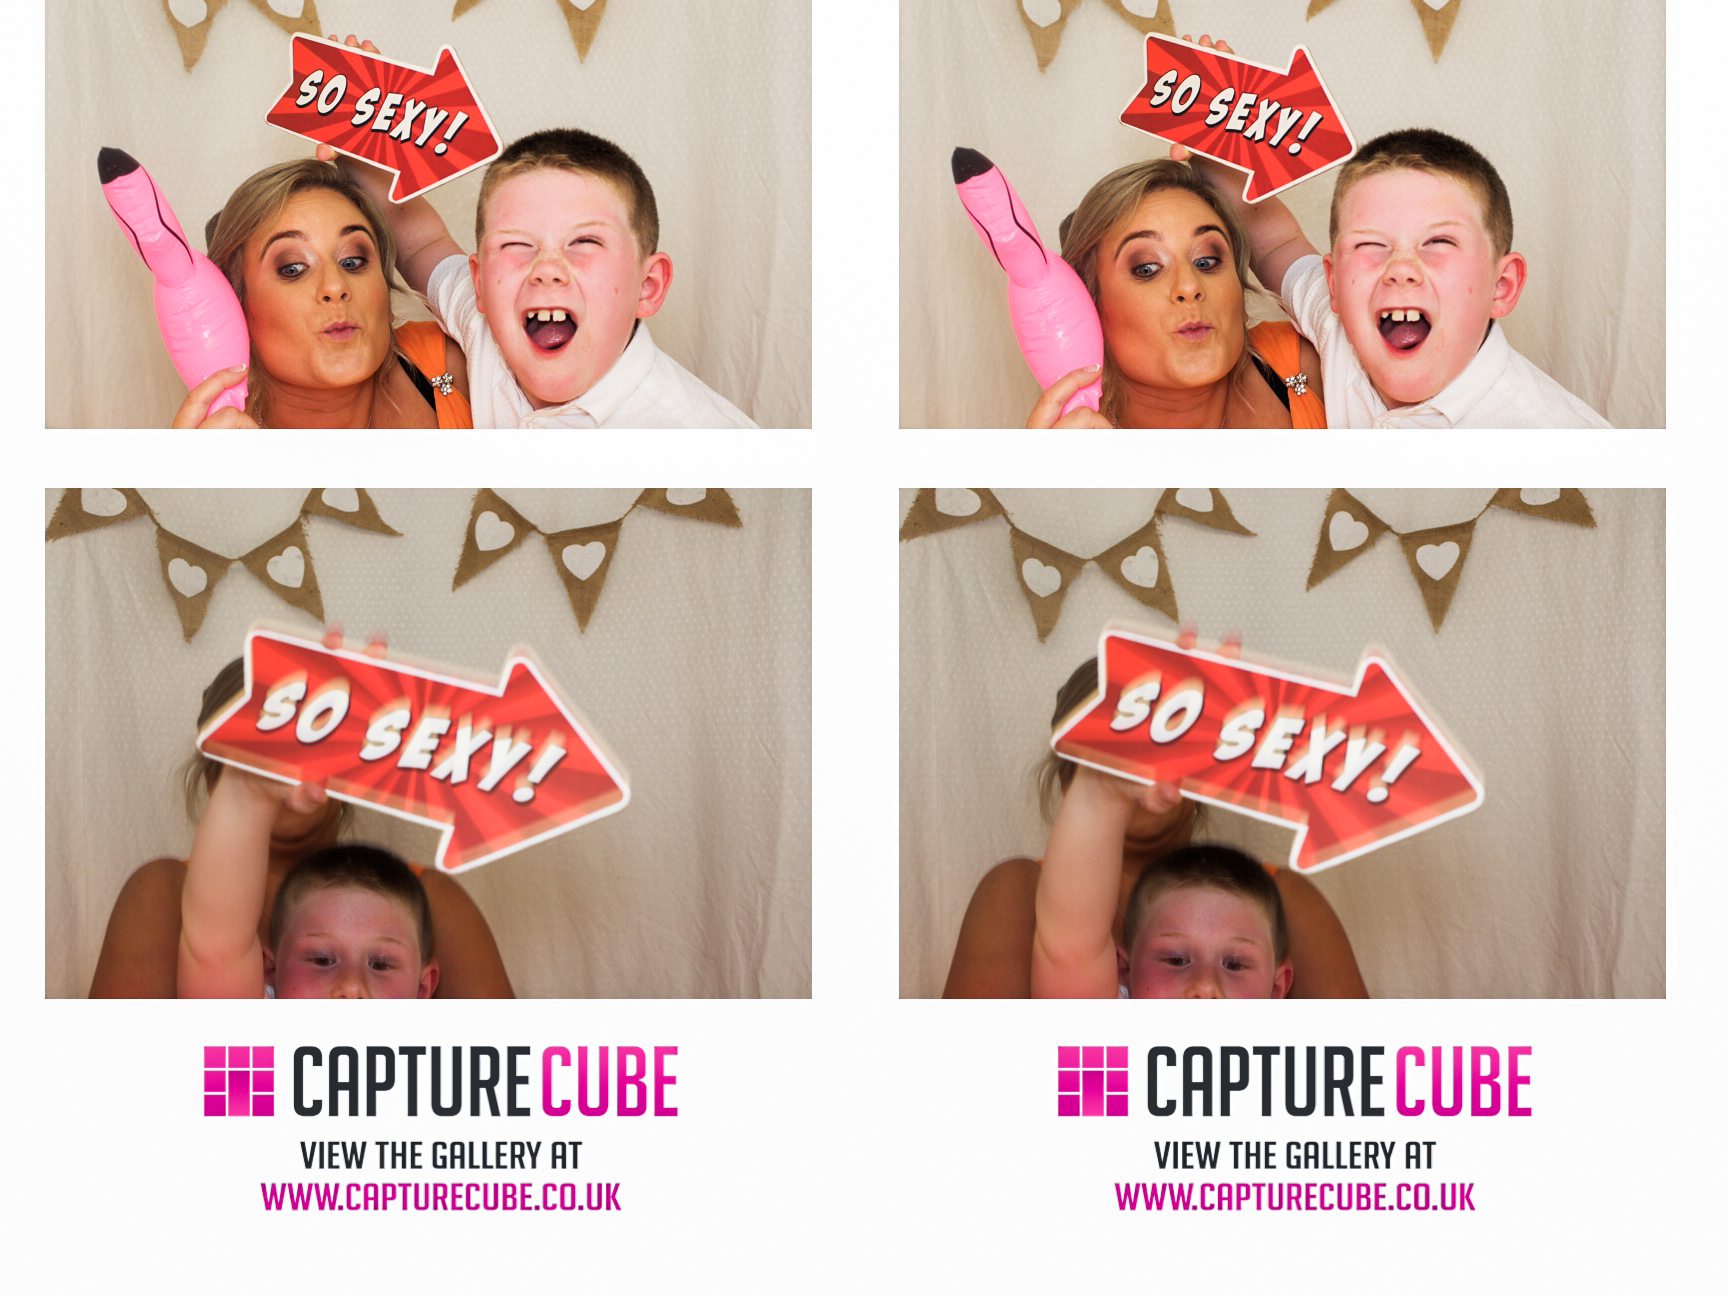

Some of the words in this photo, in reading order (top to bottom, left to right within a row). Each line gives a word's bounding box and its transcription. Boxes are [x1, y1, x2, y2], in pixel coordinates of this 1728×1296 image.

[295, 69, 348, 117] SO
[351, 86, 470, 156] SEXY!
[1149, 69, 1202, 117] SO
[1205, 86, 1324, 156] SEXY!
[255, 676, 350, 745] SO
[358, 704, 569, 805] SEXY!
[1109, 676, 1204, 745] SO
[1212, 704, 1423, 805] SEXY!
